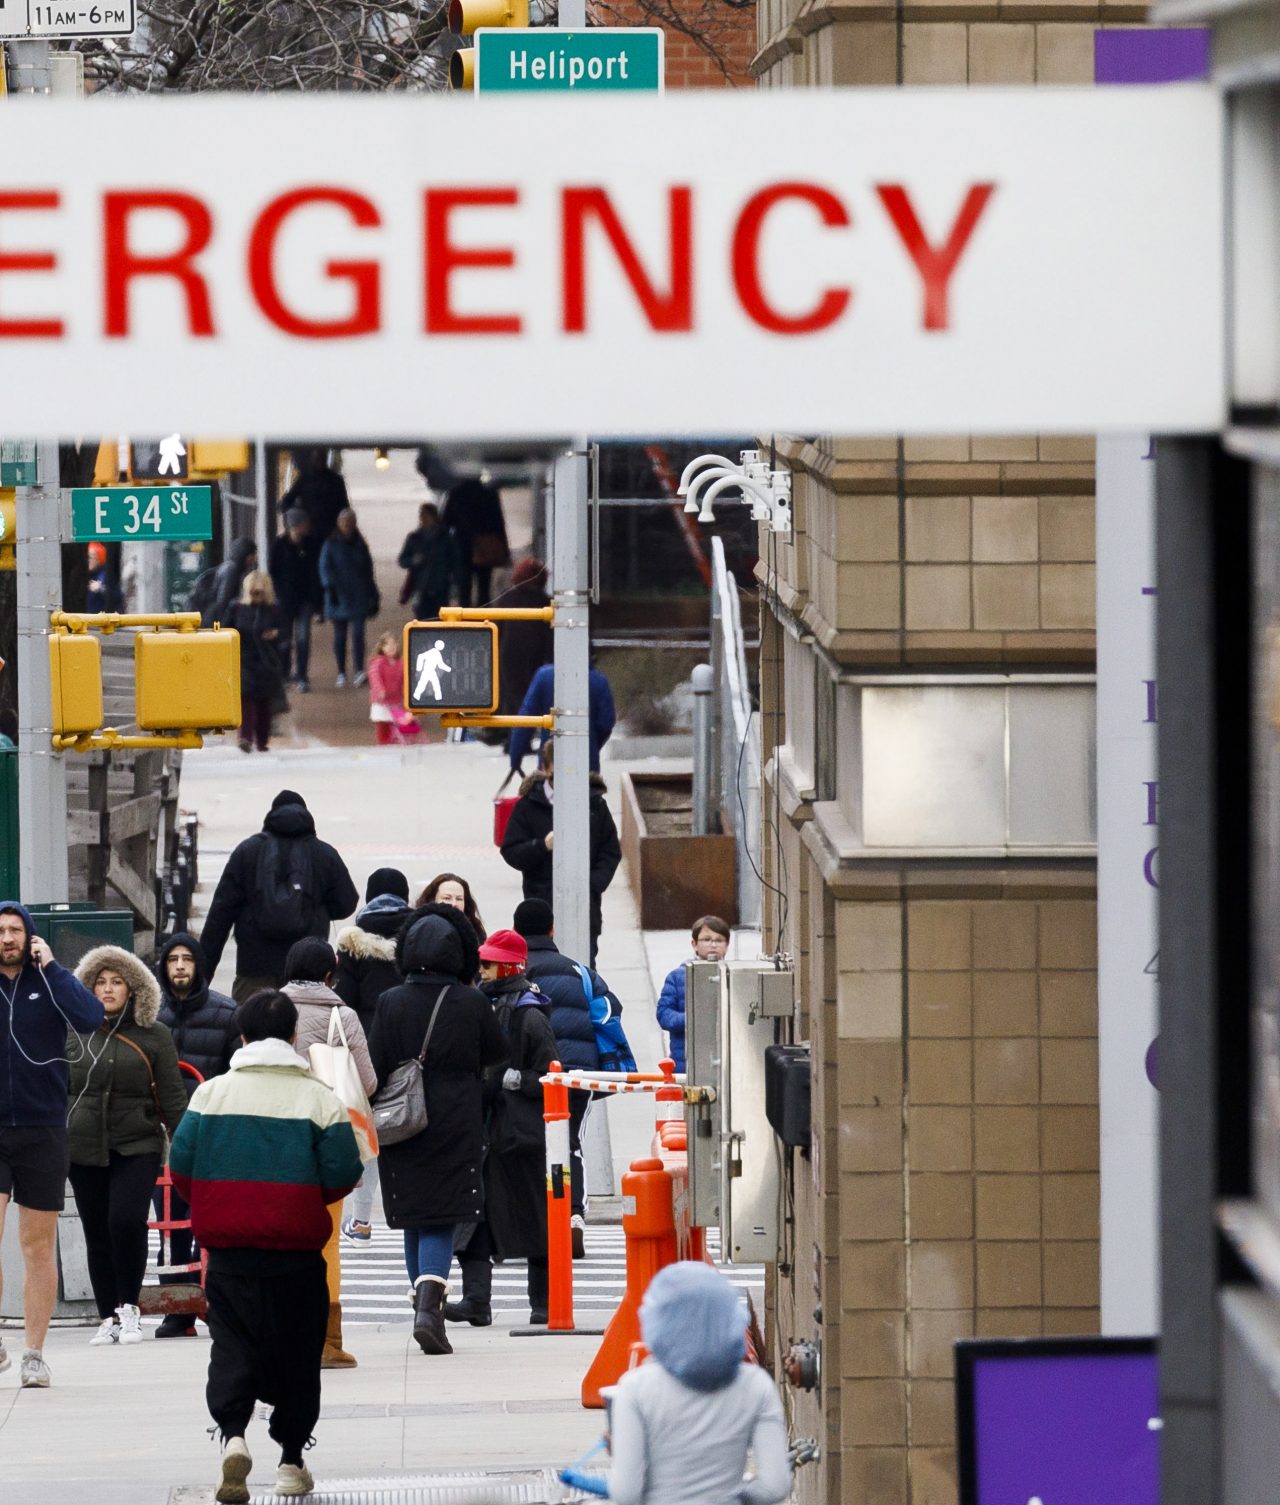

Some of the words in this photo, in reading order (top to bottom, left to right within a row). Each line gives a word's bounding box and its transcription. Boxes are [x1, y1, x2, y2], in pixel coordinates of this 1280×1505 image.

[510, 49, 630, 87] Heliport
[95, 496, 111, 534] E
[123, 495, 162, 534] 34
[171, 491, 189, 515] St
